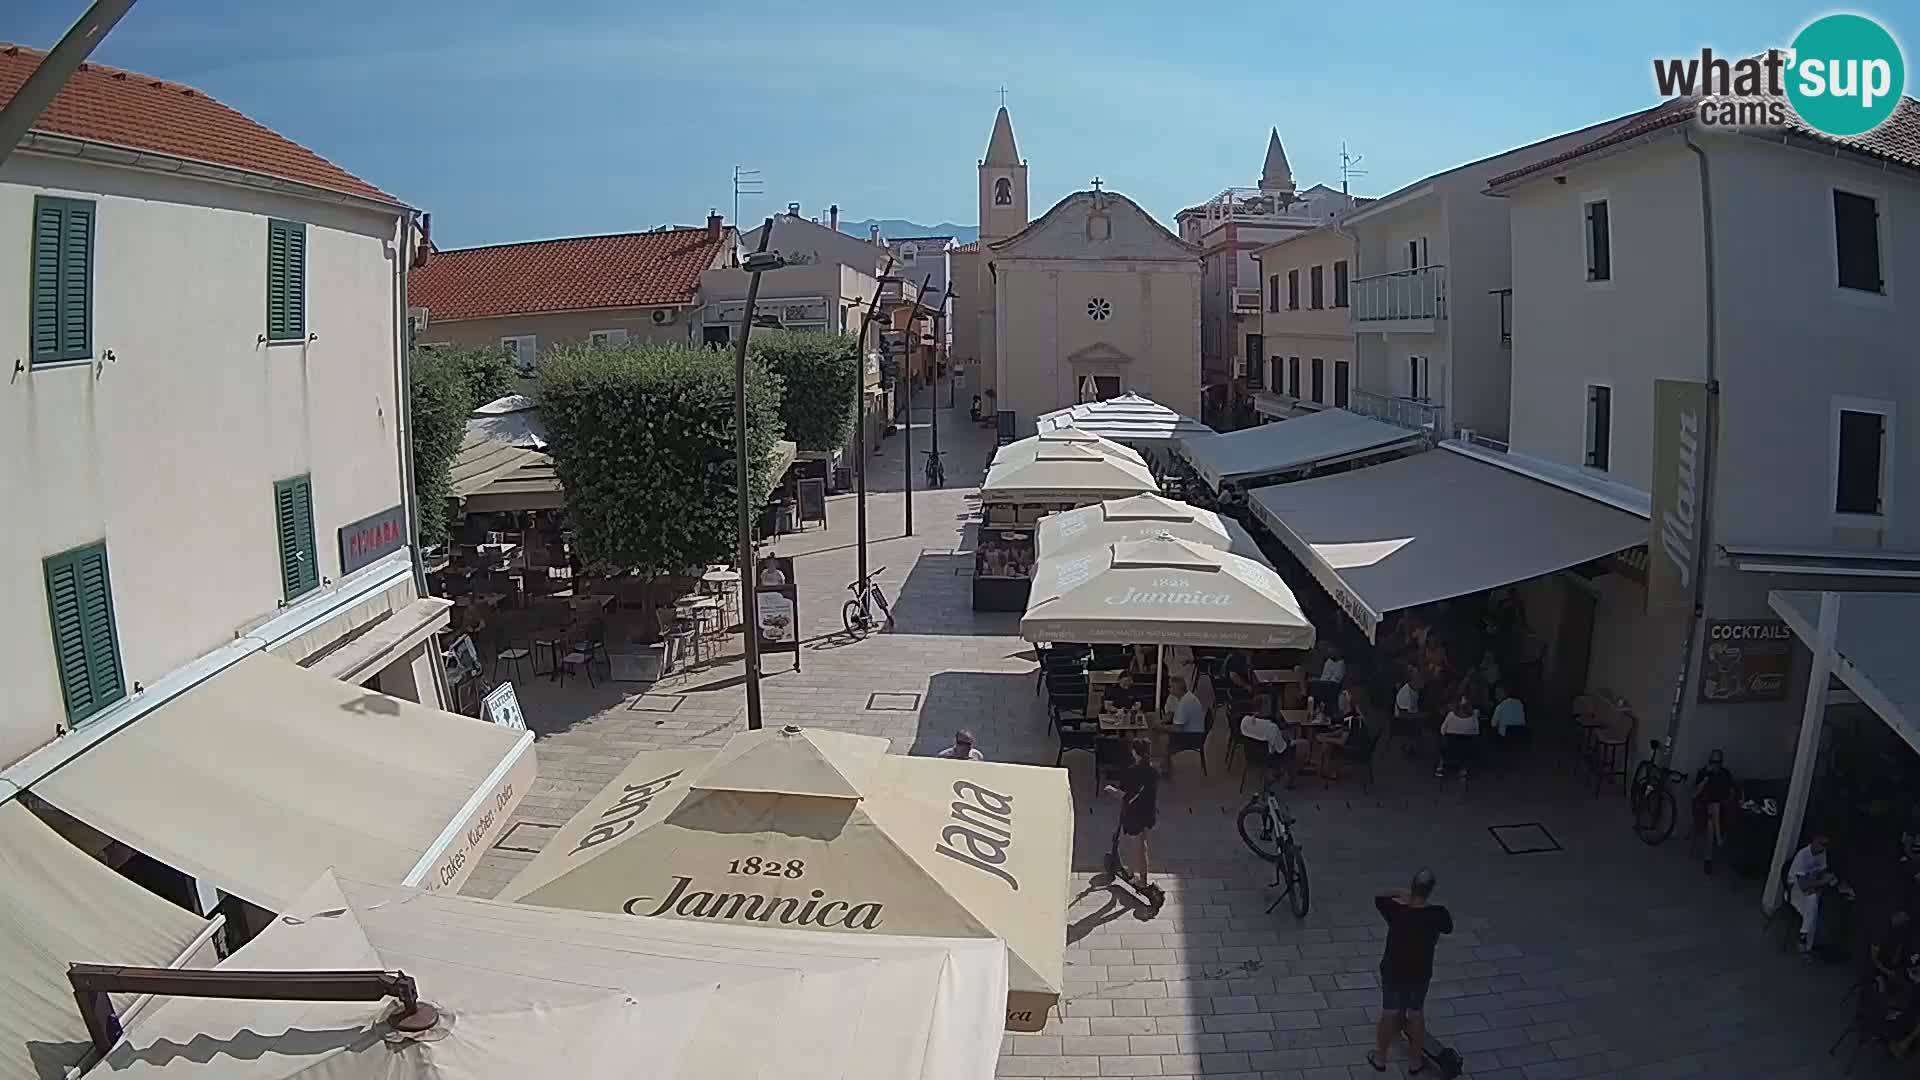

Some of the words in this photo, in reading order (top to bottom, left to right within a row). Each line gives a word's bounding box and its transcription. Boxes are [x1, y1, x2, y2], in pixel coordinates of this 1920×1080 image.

[1711, 625, 1791, 639] COCKTAILS
[567, 768, 684, 857] Jana
[935, 780, 1019, 891] Jana
[440, 848, 466, 886] Cakes
[726, 856, 805, 879] 1828
[622, 875, 884, 930] Jamnica
